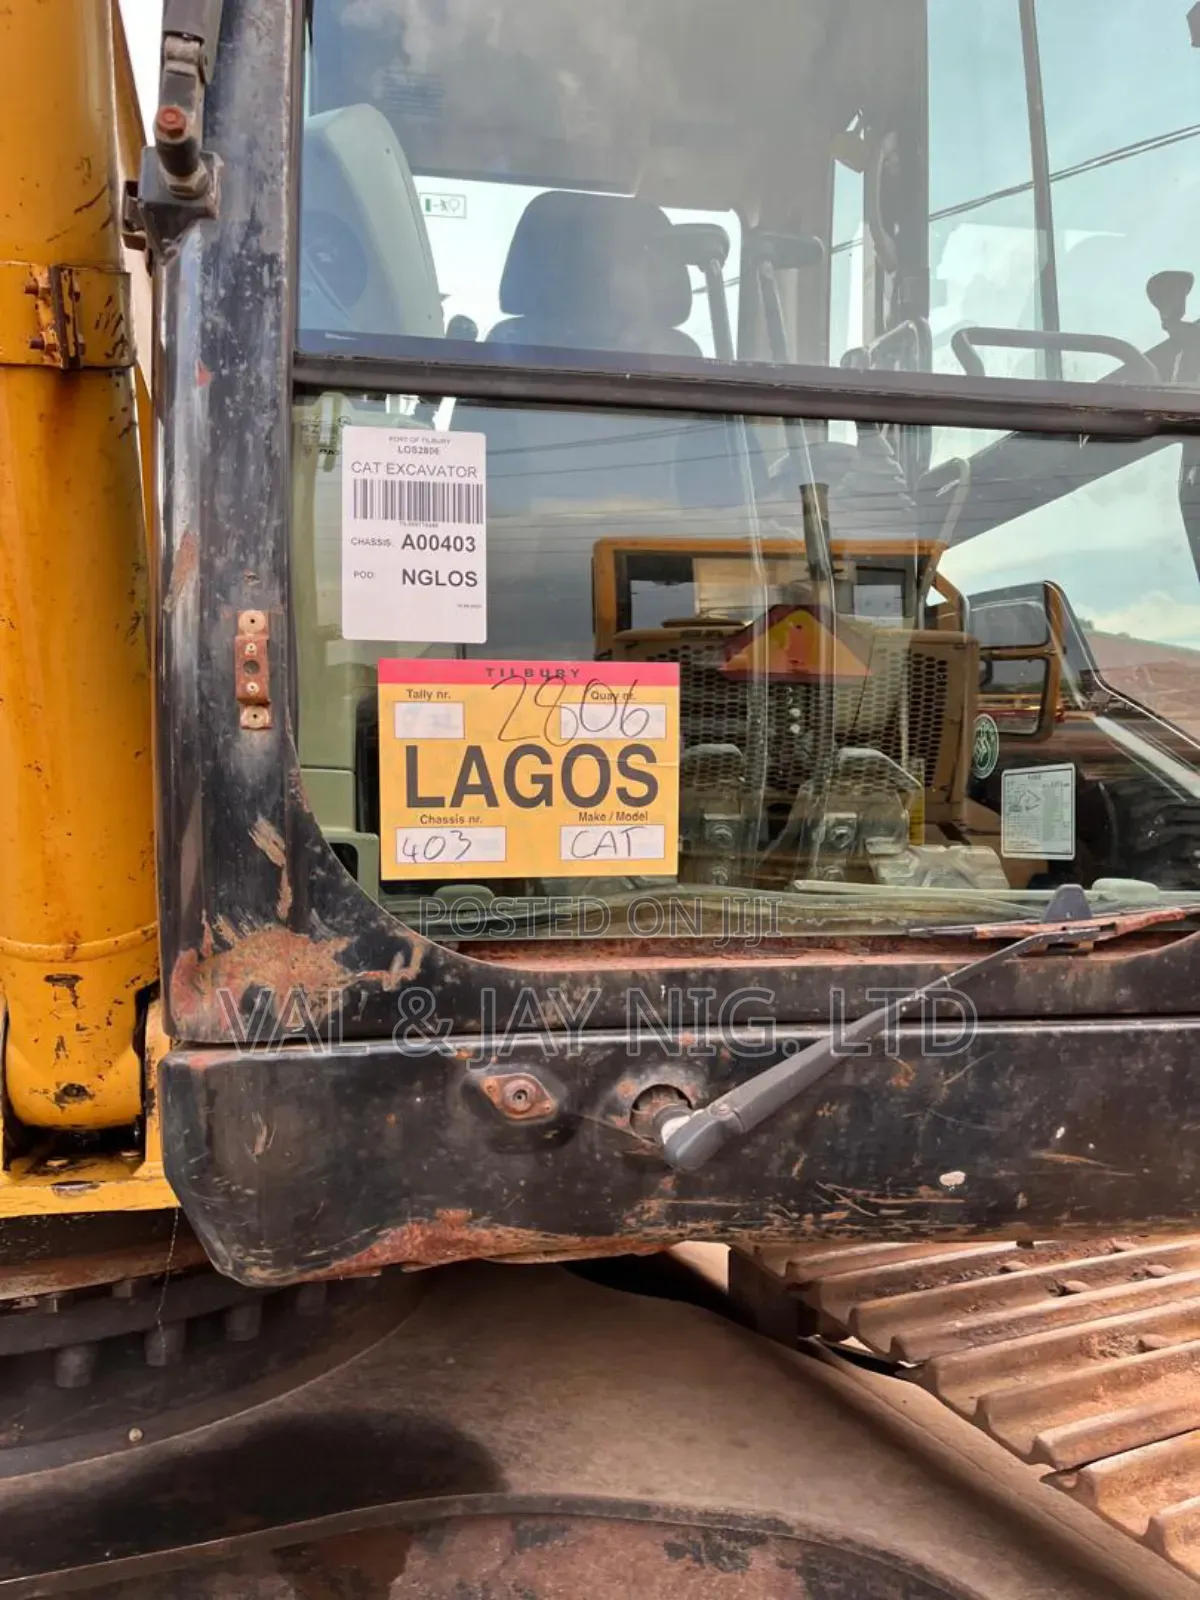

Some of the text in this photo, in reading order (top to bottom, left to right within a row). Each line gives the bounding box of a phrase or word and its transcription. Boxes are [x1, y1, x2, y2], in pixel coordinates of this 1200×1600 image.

[421, 437, 450, 445] TILBURY
[351, 461, 478, 478] CAT EXCAVATOR
[401, 533, 476, 553] A00403
[402, 568, 478, 587] NGLOS
[485, 668, 580, 679] TILBURY
[406, 688, 451, 700] Tally nr.
[590, 690, 617, 701] Quay
[491, 675, 649, 747] 2806
[405, 743, 659, 809] LAGOS
[420, 813, 483, 825] Chassis nr.
[578, 811, 606, 822] Make
[616, 811, 648, 822] Model
[402, 830, 472, 863] 403
[571, 826, 647, 858] CAT
